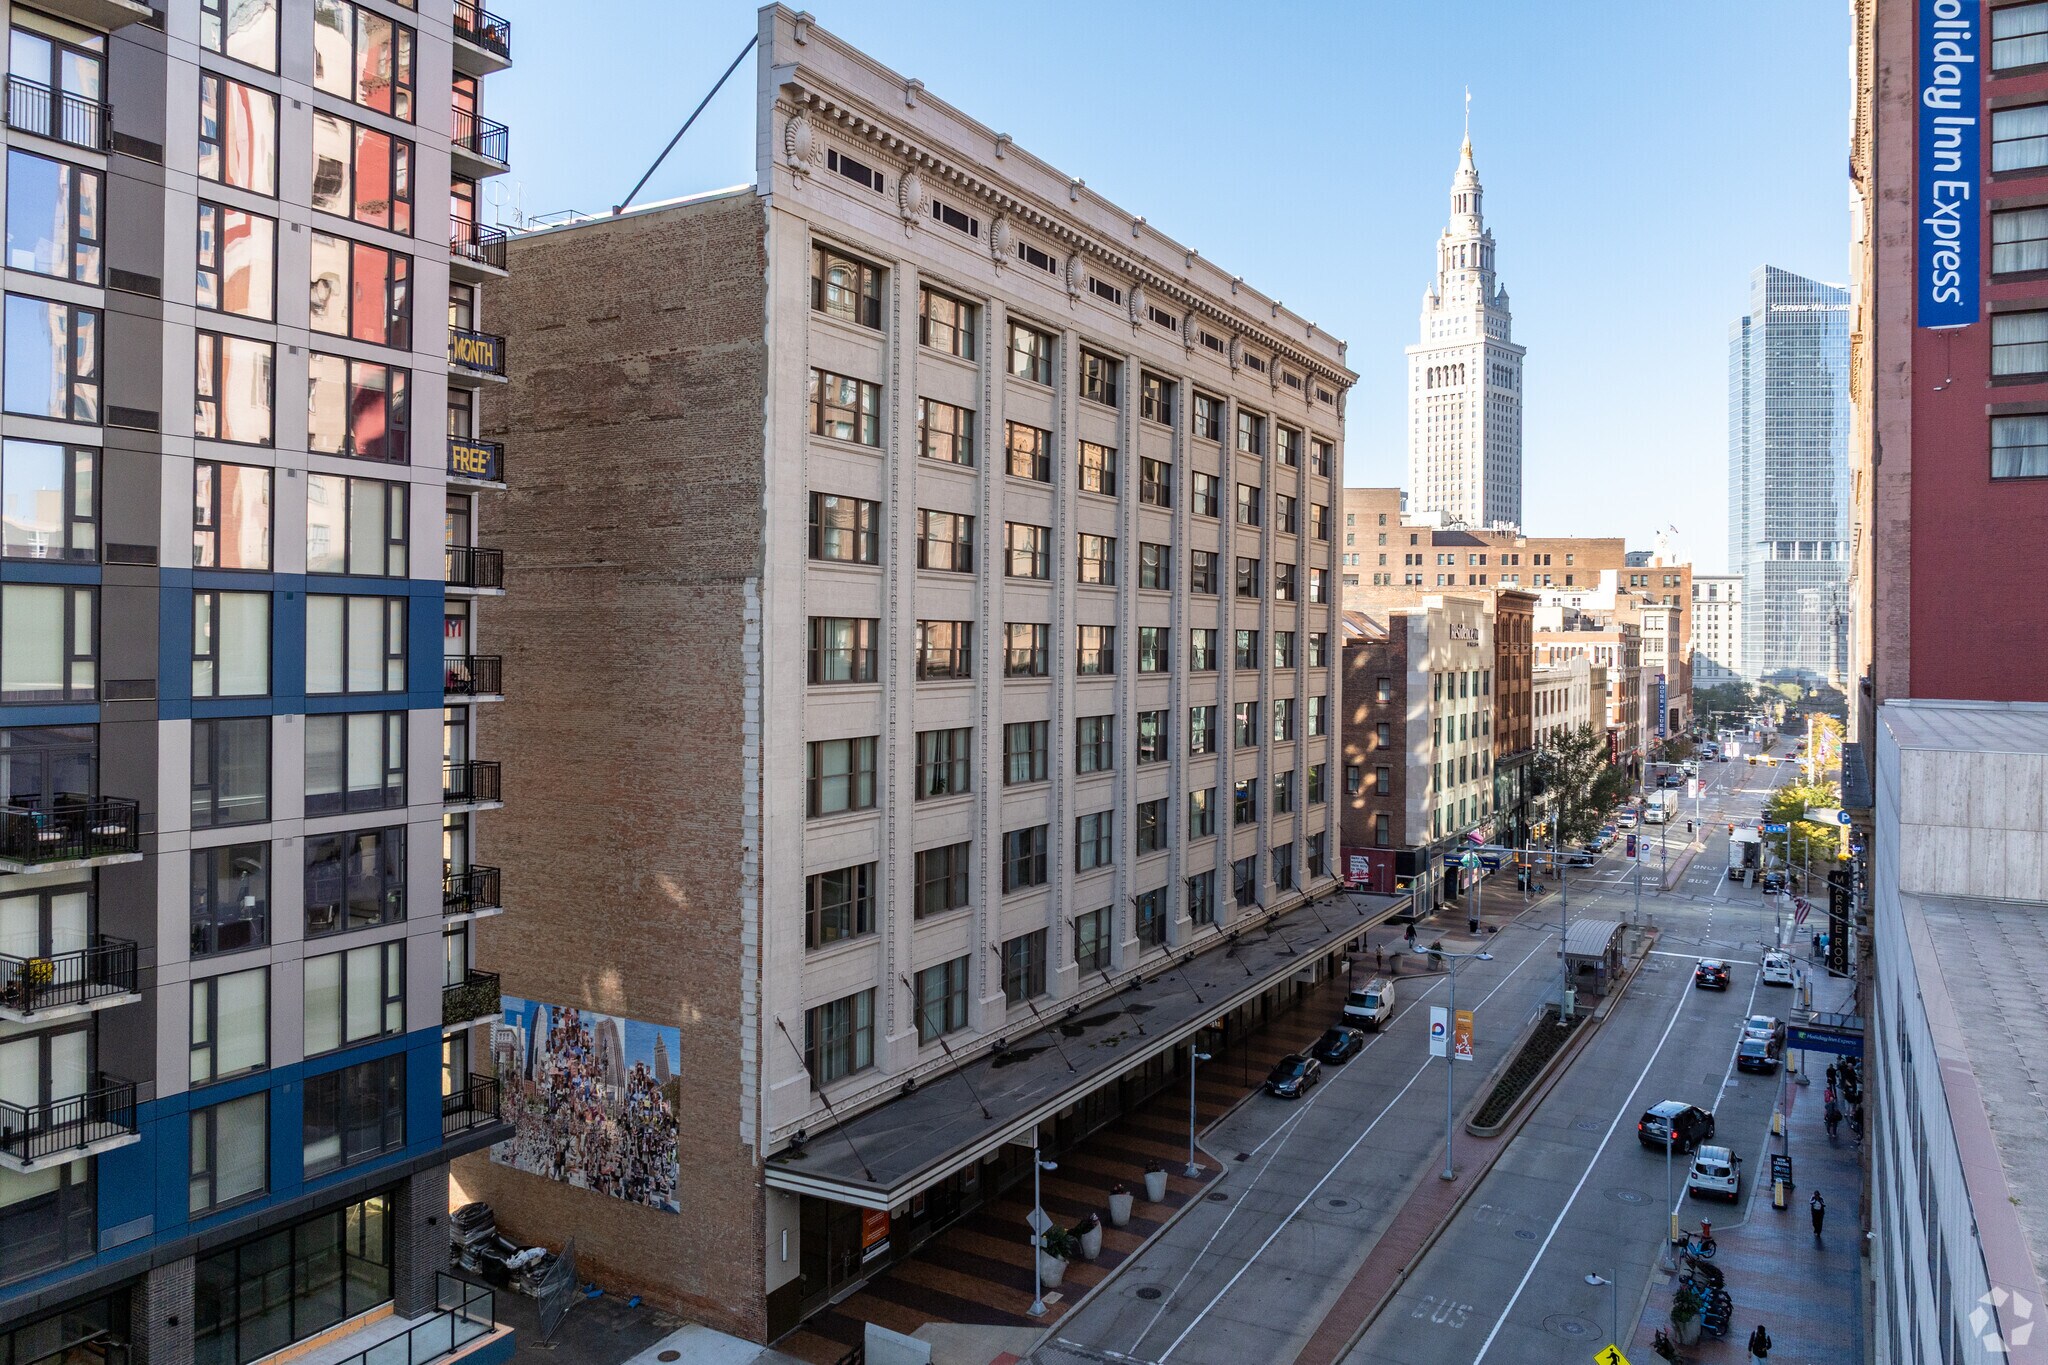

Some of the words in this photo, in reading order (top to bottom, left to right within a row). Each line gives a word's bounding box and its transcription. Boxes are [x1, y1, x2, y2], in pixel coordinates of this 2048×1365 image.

[1933, 117, 1975, 172] Inn
[1923, 180, 1970, 303] Express
[453, 335, 493, 366] MONTH
[1841, 813, 1850, 821] P
[1411, 1295, 1474, 1329] BUS
